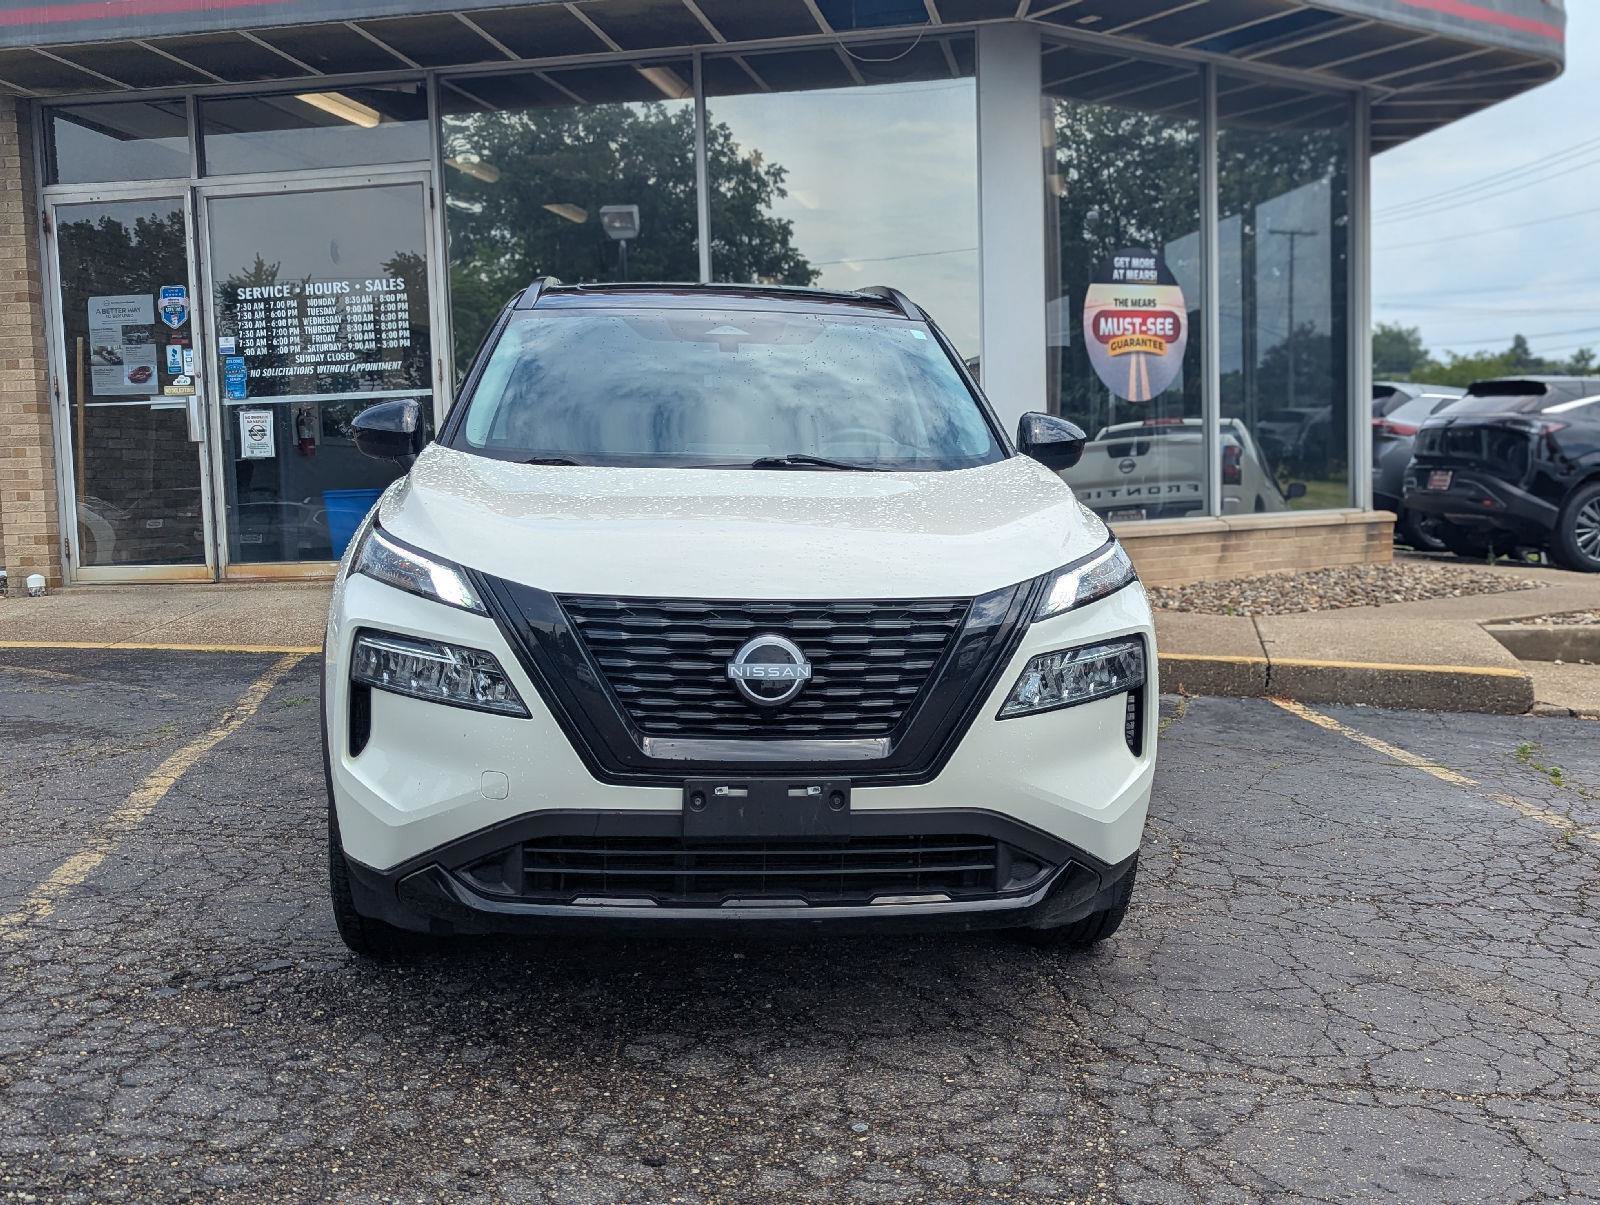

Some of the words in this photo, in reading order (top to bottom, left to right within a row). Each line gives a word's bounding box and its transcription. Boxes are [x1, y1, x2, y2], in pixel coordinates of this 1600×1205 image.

[1114, 258, 1130, 269] GET
[1132, 258, 1156, 269] MORE
[1112, 270, 1124, 280] AT
[237, 285, 290, 299] SERVICE
[306, 281, 350, 295] HOURS
[365, 278, 405, 291] SALES
[307, 297, 336, 306] MONDAY
[362, 295, 372, 303] AM
[397, 293, 407, 301] PM
[1114, 299, 1129, 307] THE
[1131, 299, 1157, 308] MEARS
[307, 306, 336, 315] TUESDAY
[255, 320, 265, 328] AM
[302, 315, 342, 325] WEDNESDAY
[1100, 318, 1173, 336] MUST-SEE
[256, 329, 266, 337] AM
[290, 327, 299, 335] PM
[304, 325, 339, 334] THURSDAY
[312, 334, 335, 343] FRIDAY
[1111, 337, 1164, 350] GUARANTEE
[290, 345, 300, 353] PM
[307, 343, 341, 353] SATURDAY
[365, 341, 375, 349] AM
[296, 354, 324, 364] SUNDAY
[327, 352, 355, 361] CLOSED
[250, 368, 261, 378] NO
[262, 366, 314, 377] SOLICITATIONS
[317, 365, 349, 374] WITHOUT
[351, 361, 402, 372] APPOINTMENT
[730, 667, 809, 677] NISSAN
